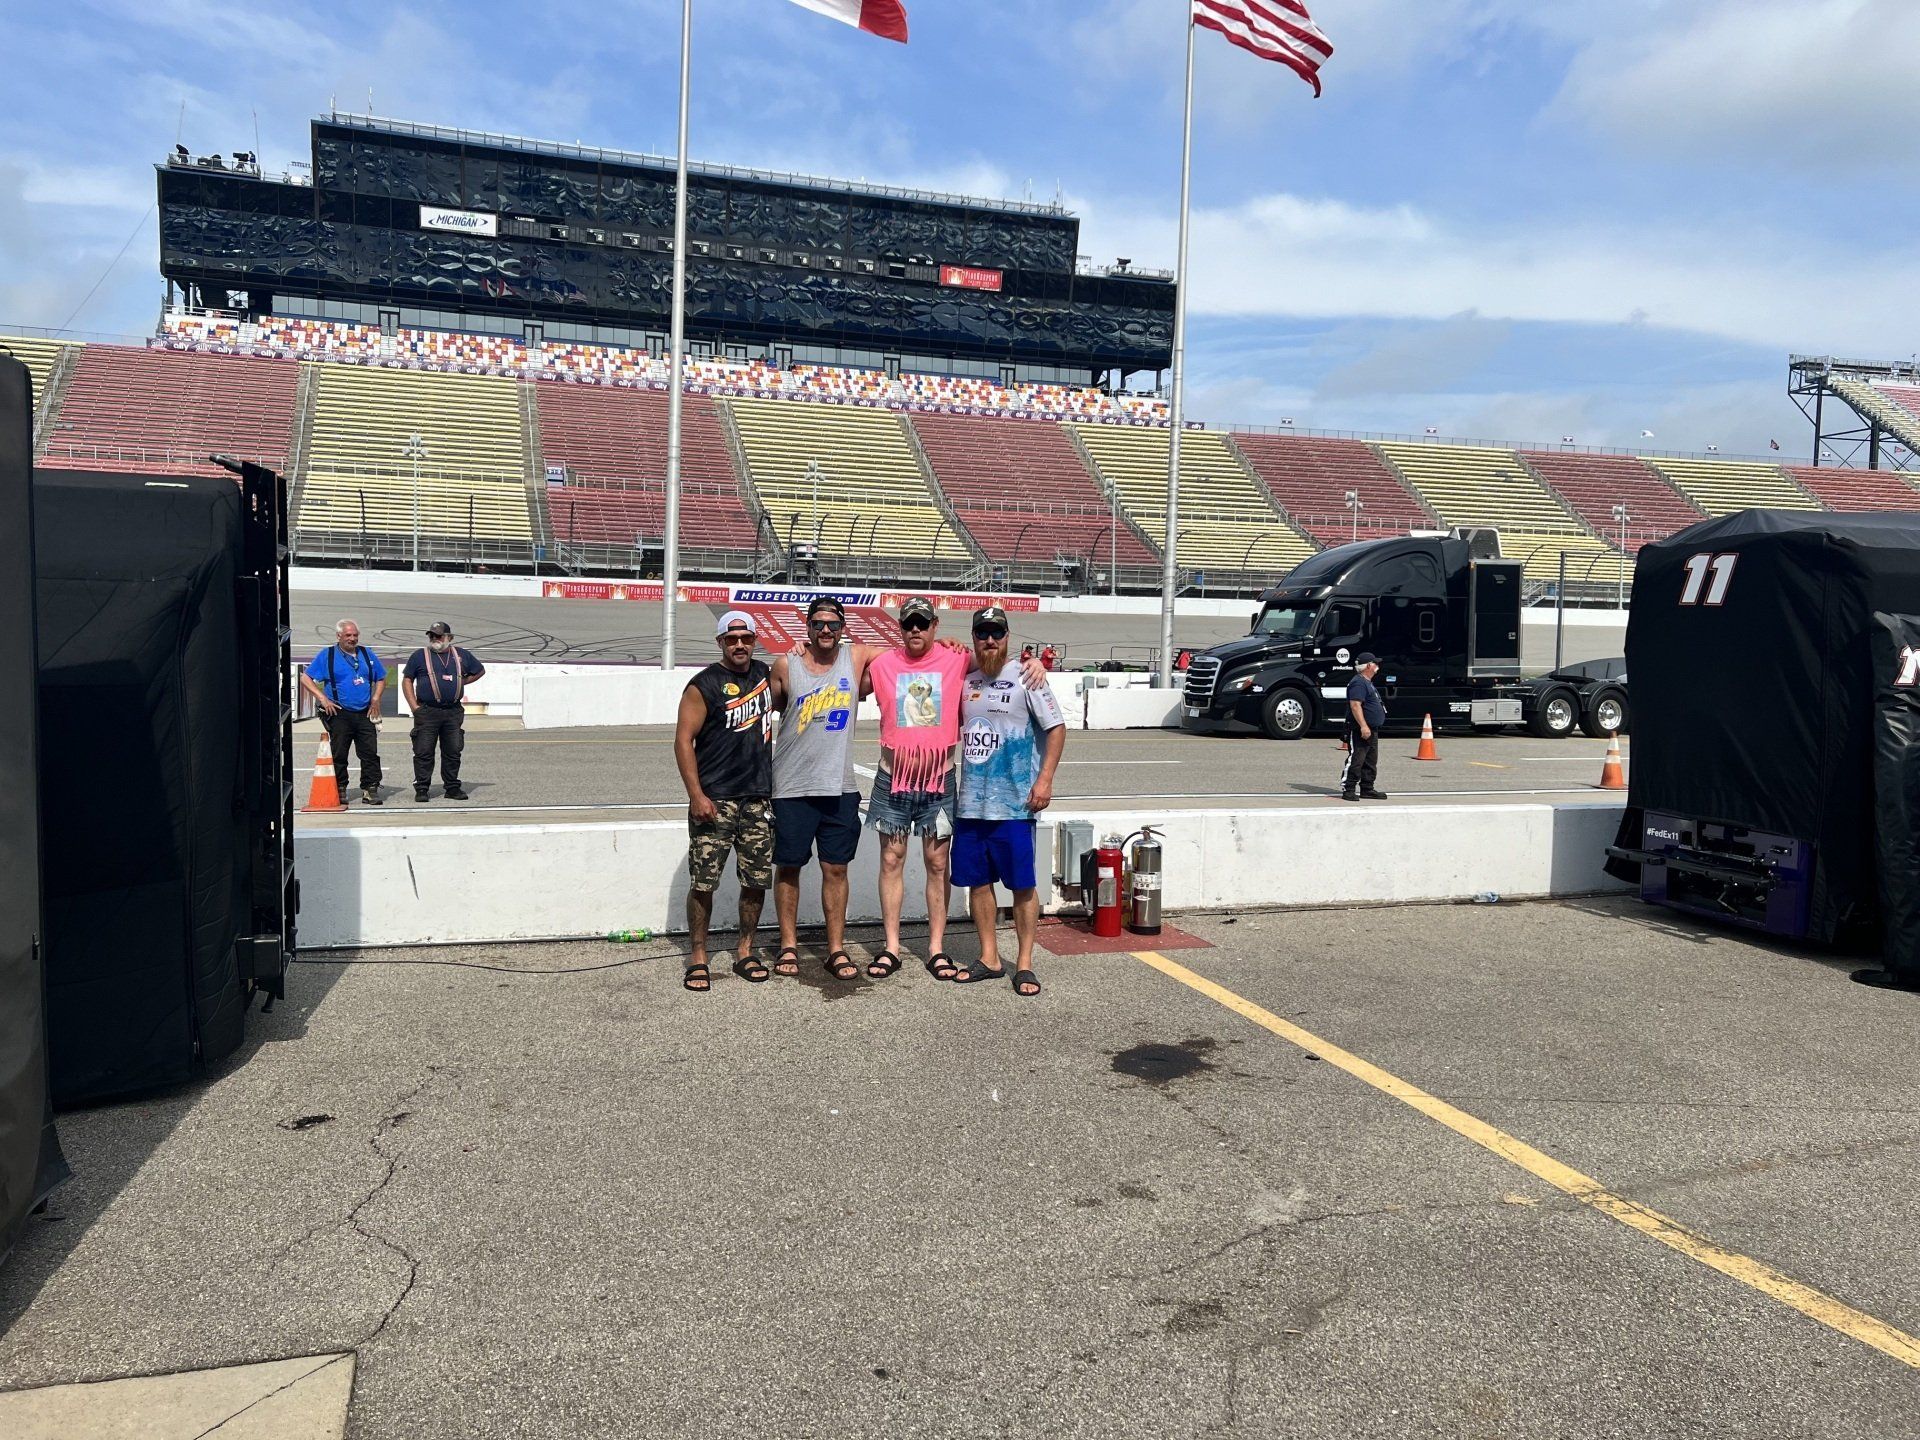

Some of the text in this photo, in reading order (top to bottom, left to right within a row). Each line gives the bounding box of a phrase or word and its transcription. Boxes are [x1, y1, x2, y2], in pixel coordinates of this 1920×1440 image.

[436, 215, 478, 227] MICHIGAN
[174, 342, 189, 351] ally
[218, 345, 233, 355] ally
[261, 349, 276, 358] ally
[303, 353, 318, 361] ally
[345, 356, 359, 365] ally
[388, 360, 402, 369] ally
[428, 363, 441, 372] ally
[467, 367, 480, 375] ally
[505, 370, 519, 378] ally
[543, 372, 556, 380] ally
[582, 376, 595, 384] ally
[619, 379, 632, 388] ally
[655, 382, 667, 391] ally
[1679, 553, 1739, 605] 11
[982, 608, 994, 618] 4
[725, 694, 761, 728] TRUEX
[824, 708, 850, 732] 9
[1647, 828, 1678, 840] #FedEx11
